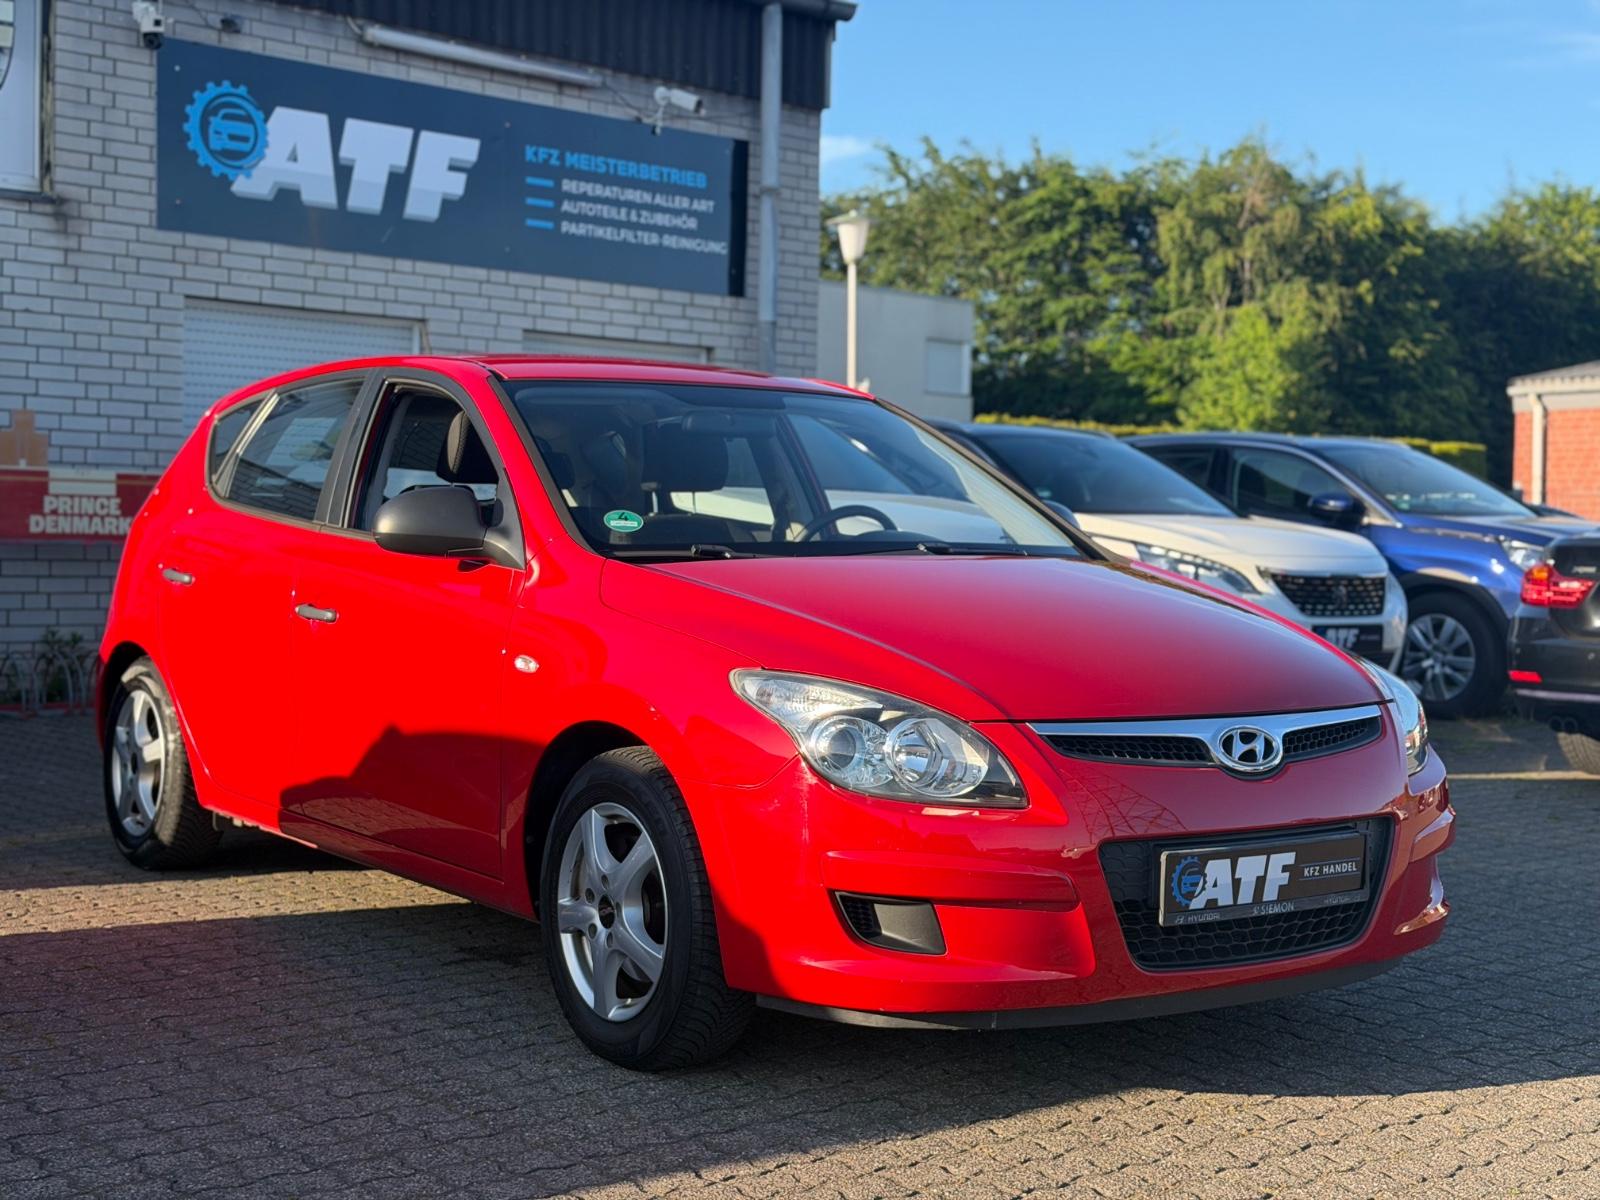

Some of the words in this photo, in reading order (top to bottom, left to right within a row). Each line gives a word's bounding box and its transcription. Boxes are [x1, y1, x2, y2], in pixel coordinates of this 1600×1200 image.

[230, 106, 481, 223] ATF
[525, 145, 561, 166] KFZ
[565, 152, 708, 188] MEISTERBETRIEB
[561, 179, 650, 204] REPERATUREN
[653, 192, 691, 210] ALLER
[691, 199, 715, 213] ART
[561, 199, 628, 221] AUTOTEILE
[630, 208, 638, 223] &
[640, 209, 698, 230] ZUBEHÖR
[561, 221, 728, 255] PARTIKELFILTER-REINIGUNG
[43, 495, 122, 515] PRINCE
[617, 511, 628, 521] 4
[29, 514, 134, 535] DENMARK
[1188, 852, 1297, 910] ATF
[1303, 866, 1320, 877] KFZ
[1322, 861, 1358, 875] HANDEL
